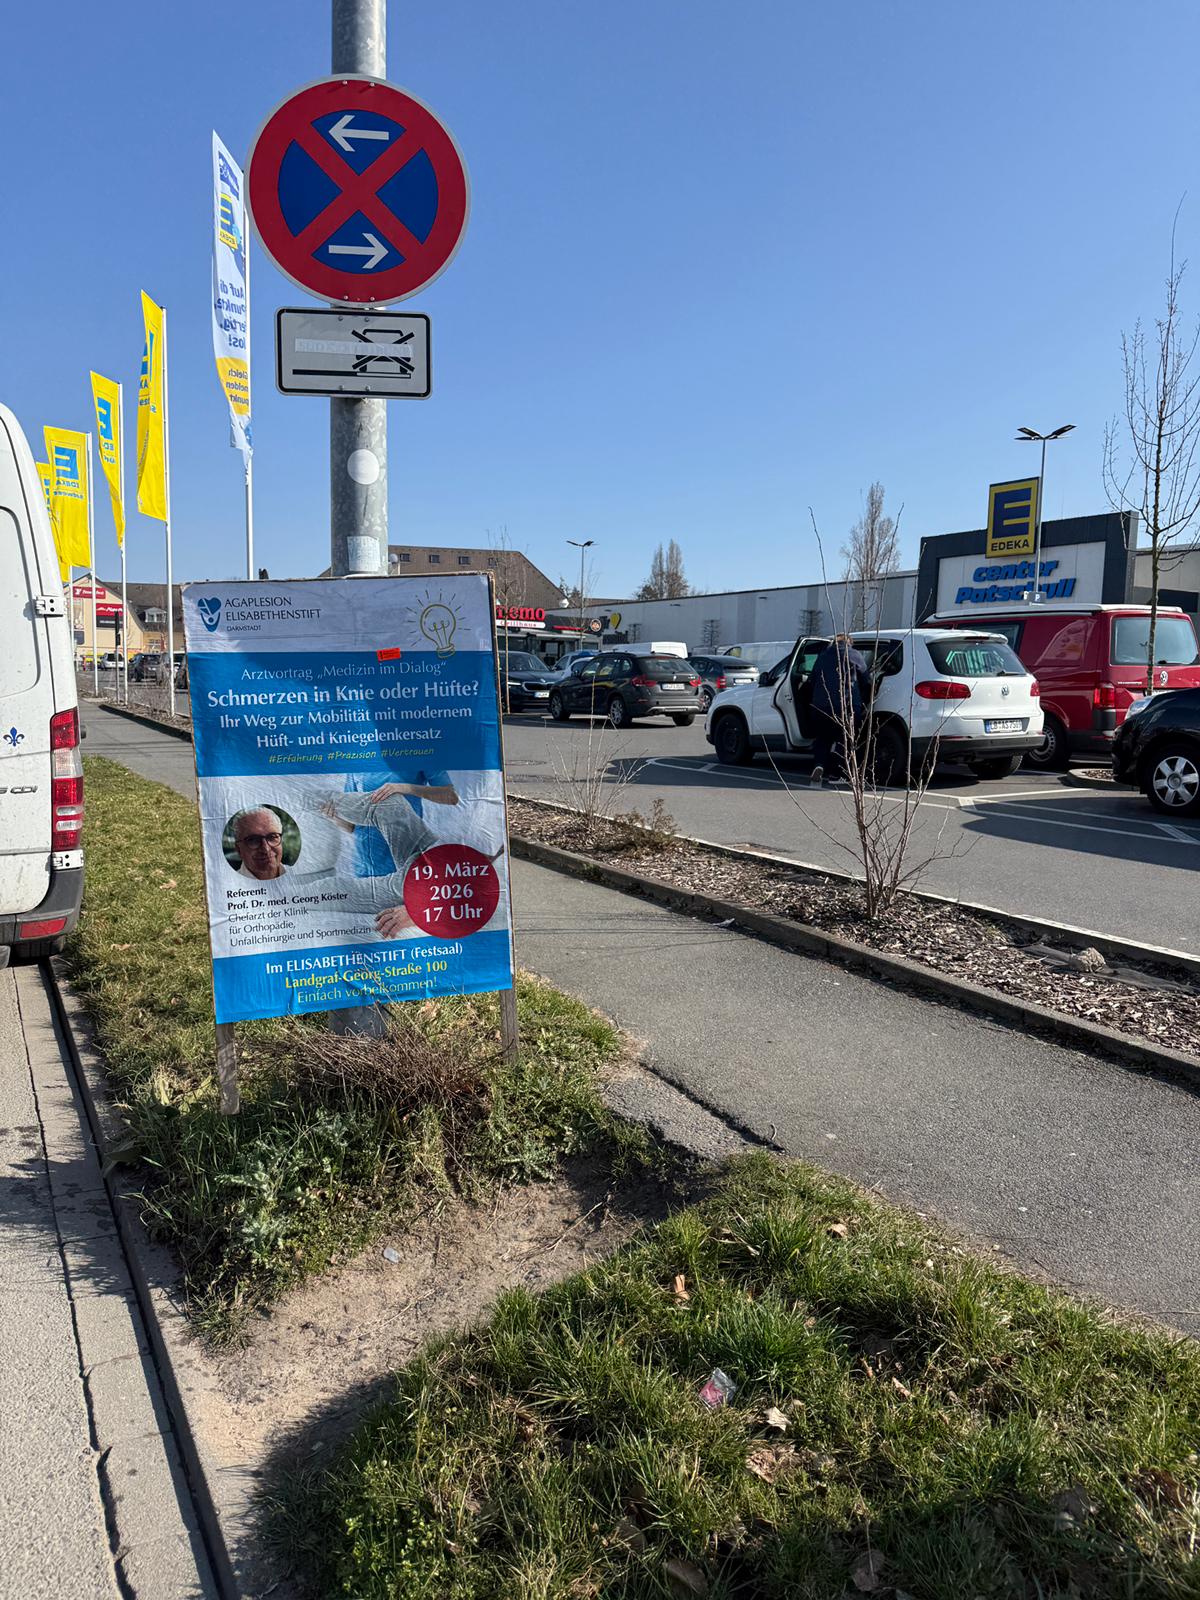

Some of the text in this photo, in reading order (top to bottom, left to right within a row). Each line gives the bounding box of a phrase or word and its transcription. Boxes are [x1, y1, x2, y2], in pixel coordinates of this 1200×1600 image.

[991, 539, 1030, 551] EDEKA
[974, 561, 1059, 582] center
[224, 597, 292, 608] AGAPLESION
[226, 609, 321, 621] ELISABETHENSTIFT
[241, 661, 447, 681] Arztvortrag „Medizin im Dialog“
[207, 680, 479, 707] Schmerzen in Knie oder Hüfte?
[220, 705, 472, 730] Ihr Weg zur Mobilität mit modernem
[257, 728, 442, 748] Hüft- und Kniegelenkersatz
[269, 752, 323, 764] #Erfahrung
[10, 785, 38, 795] CDI
[412, 863, 489, 881] 19. März
[227, 887, 266, 898] Referent:
[227, 891, 348, 910] Prof. Dr. med. Georg Köster
[430, 885, 473, 901] 2026
[229, 906, 308, 922] Chefarzt der Klinik
[424, 905, 483, 923] 17 Uhr
[229, 921, 296, 935] für Orthopädie,
[230, 925, 371, 946] Unfallchirurgie und Sportmedizin
[266, 944, 463, 973] Im ELISABETHENSTIFT (Festsaal)
[285, 960, 447, 988] Landgraf-Georg-Straße 100
[298, 976, 438, 1002] Einfach vorbeikommen!
